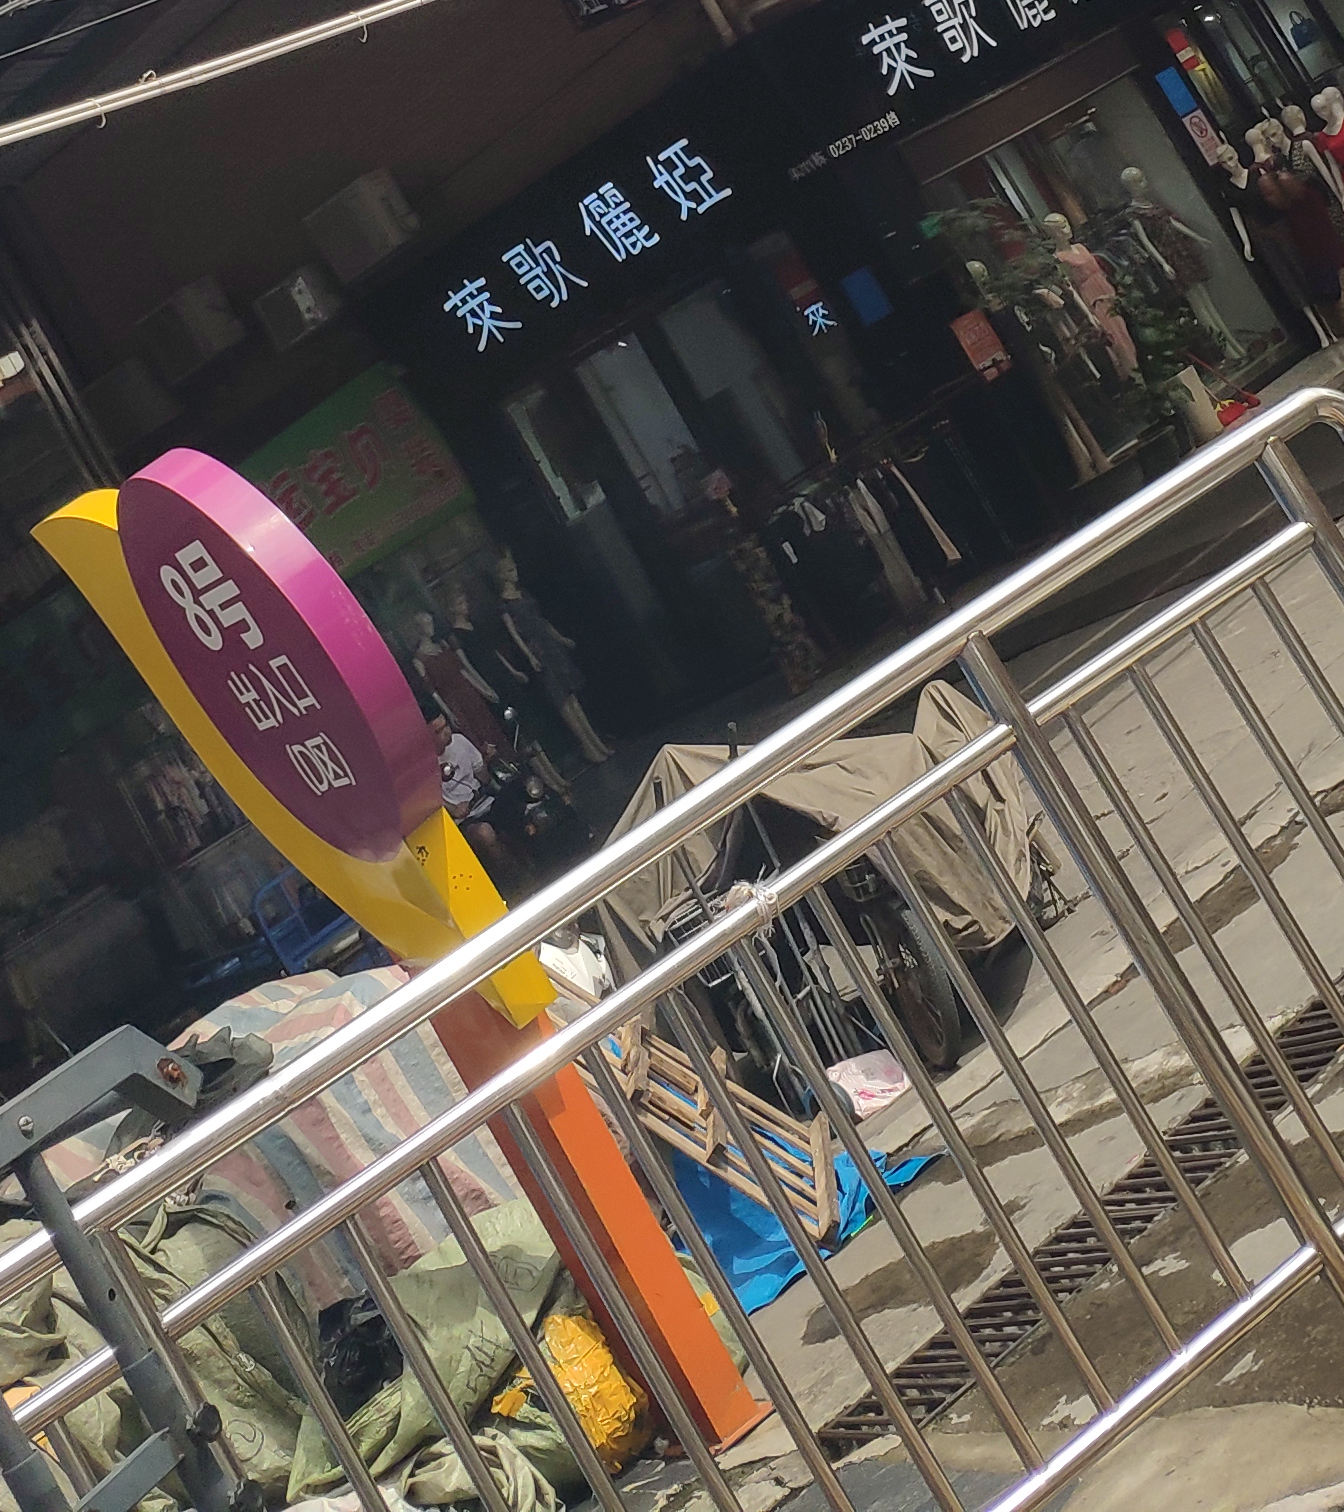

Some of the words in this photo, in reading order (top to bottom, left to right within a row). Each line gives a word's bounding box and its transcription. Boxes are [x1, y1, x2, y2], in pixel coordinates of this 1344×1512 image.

[160, 540, 264, 650] 8号
[227, 655, 321, 731] 出入口
